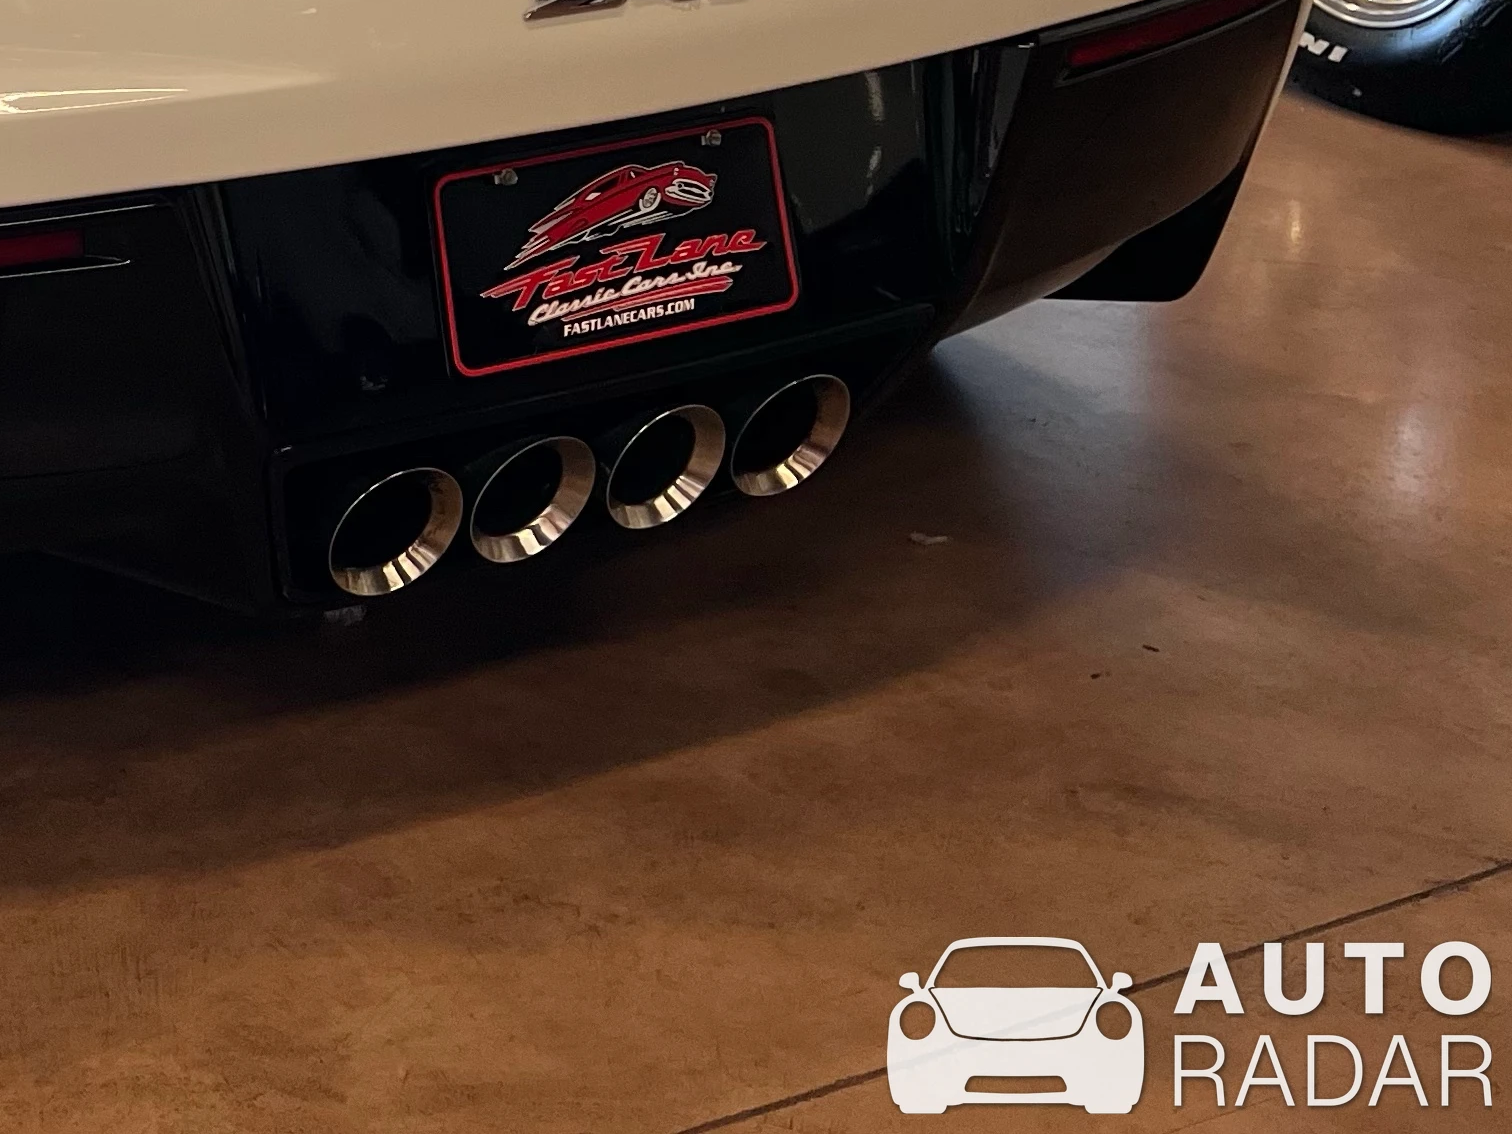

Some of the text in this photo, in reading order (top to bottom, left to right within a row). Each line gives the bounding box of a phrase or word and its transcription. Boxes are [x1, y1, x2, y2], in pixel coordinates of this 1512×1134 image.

[480, 229, 767, 311] Fast Lane
[527, 261, 743, 327] Classic Cars Inc.
[563, 298, 695, 337] FASTLANECARS.COM
